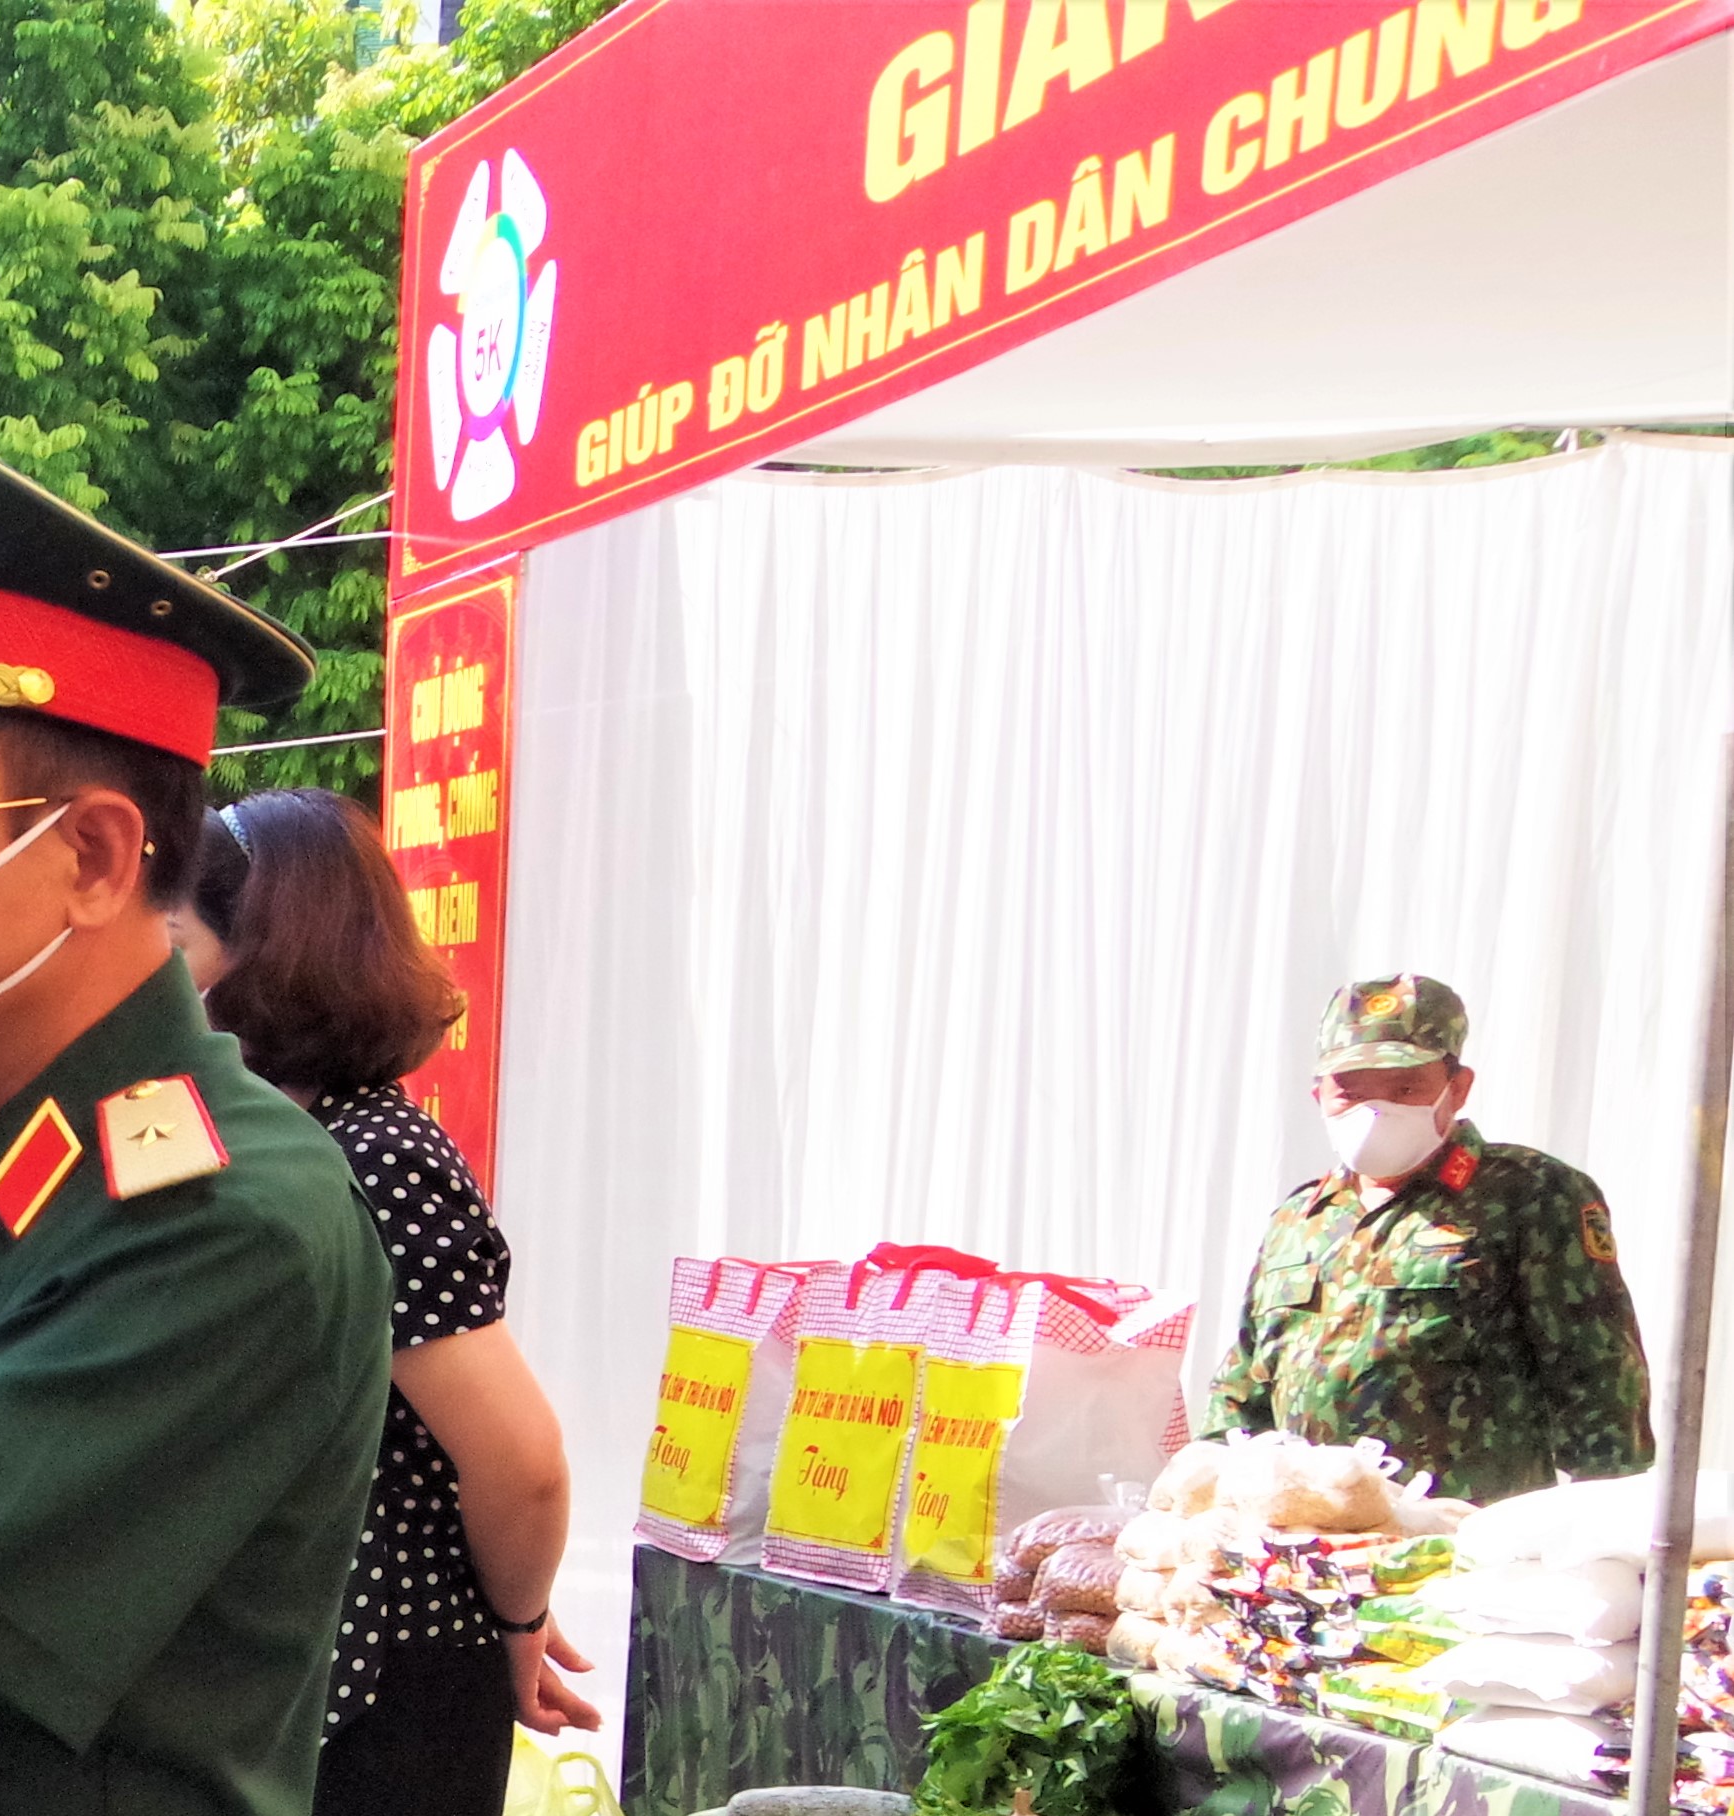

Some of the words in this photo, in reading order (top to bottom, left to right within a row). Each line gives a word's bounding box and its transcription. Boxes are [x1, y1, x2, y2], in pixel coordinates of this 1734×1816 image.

[865, 0, 1244, 203] GIA
[474, 318, 503, 381] 5K
[576, 380, 694, 488] GIÚP
[708, 320, 789, 432] ĐỠ
[800, 230, 986, 391] NHÂN
[1005, 132, 1175, 295] DÂN
[411, 655, 442, 744] CHỦ
[442, 655, 484, 747] ĐỘNG
[447, 750, 499, 840] CHỐNG
[438, 871, 479, 959] BỆNH
[875, 1393, 904, 1434] NỘI
[798, 1445, 849, 1501] Tặng
